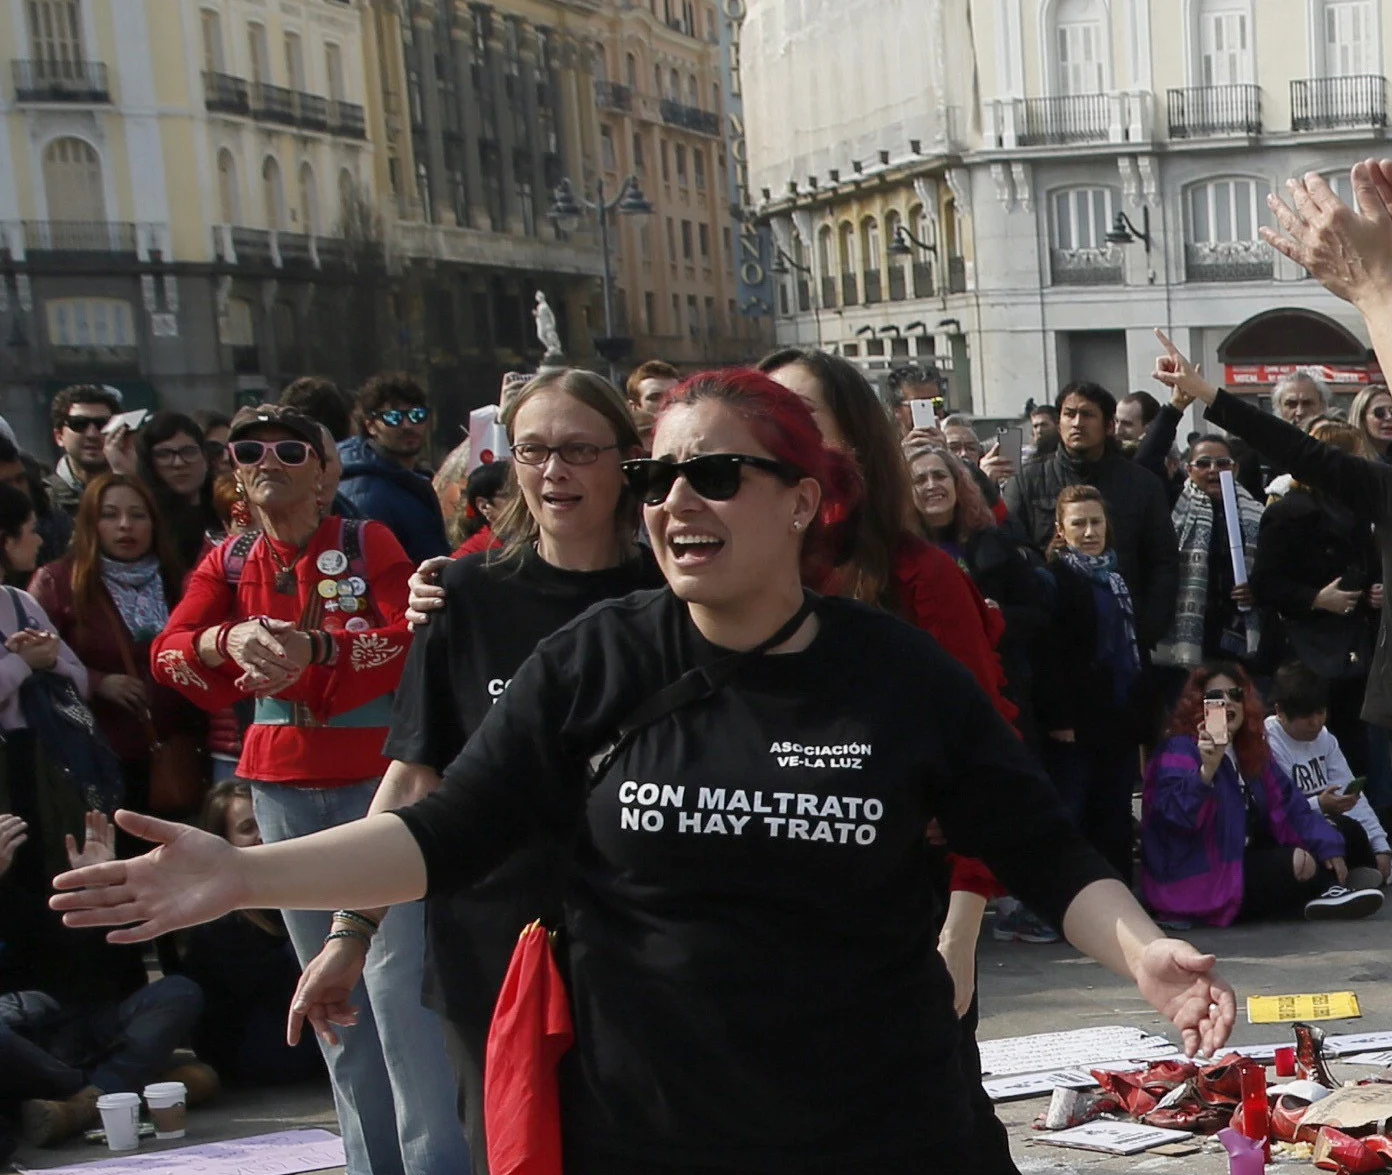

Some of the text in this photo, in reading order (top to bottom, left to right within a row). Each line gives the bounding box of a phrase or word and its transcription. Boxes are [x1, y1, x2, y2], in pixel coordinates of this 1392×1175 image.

[770, 740, 872, 756] ASOCIACIÓN
[777, 756, 863, 769] VE-LA LUZ
[618, 780, 885, 822] CON MALTRATO
[620, 807, 877, 846] NO HAY TRATO
